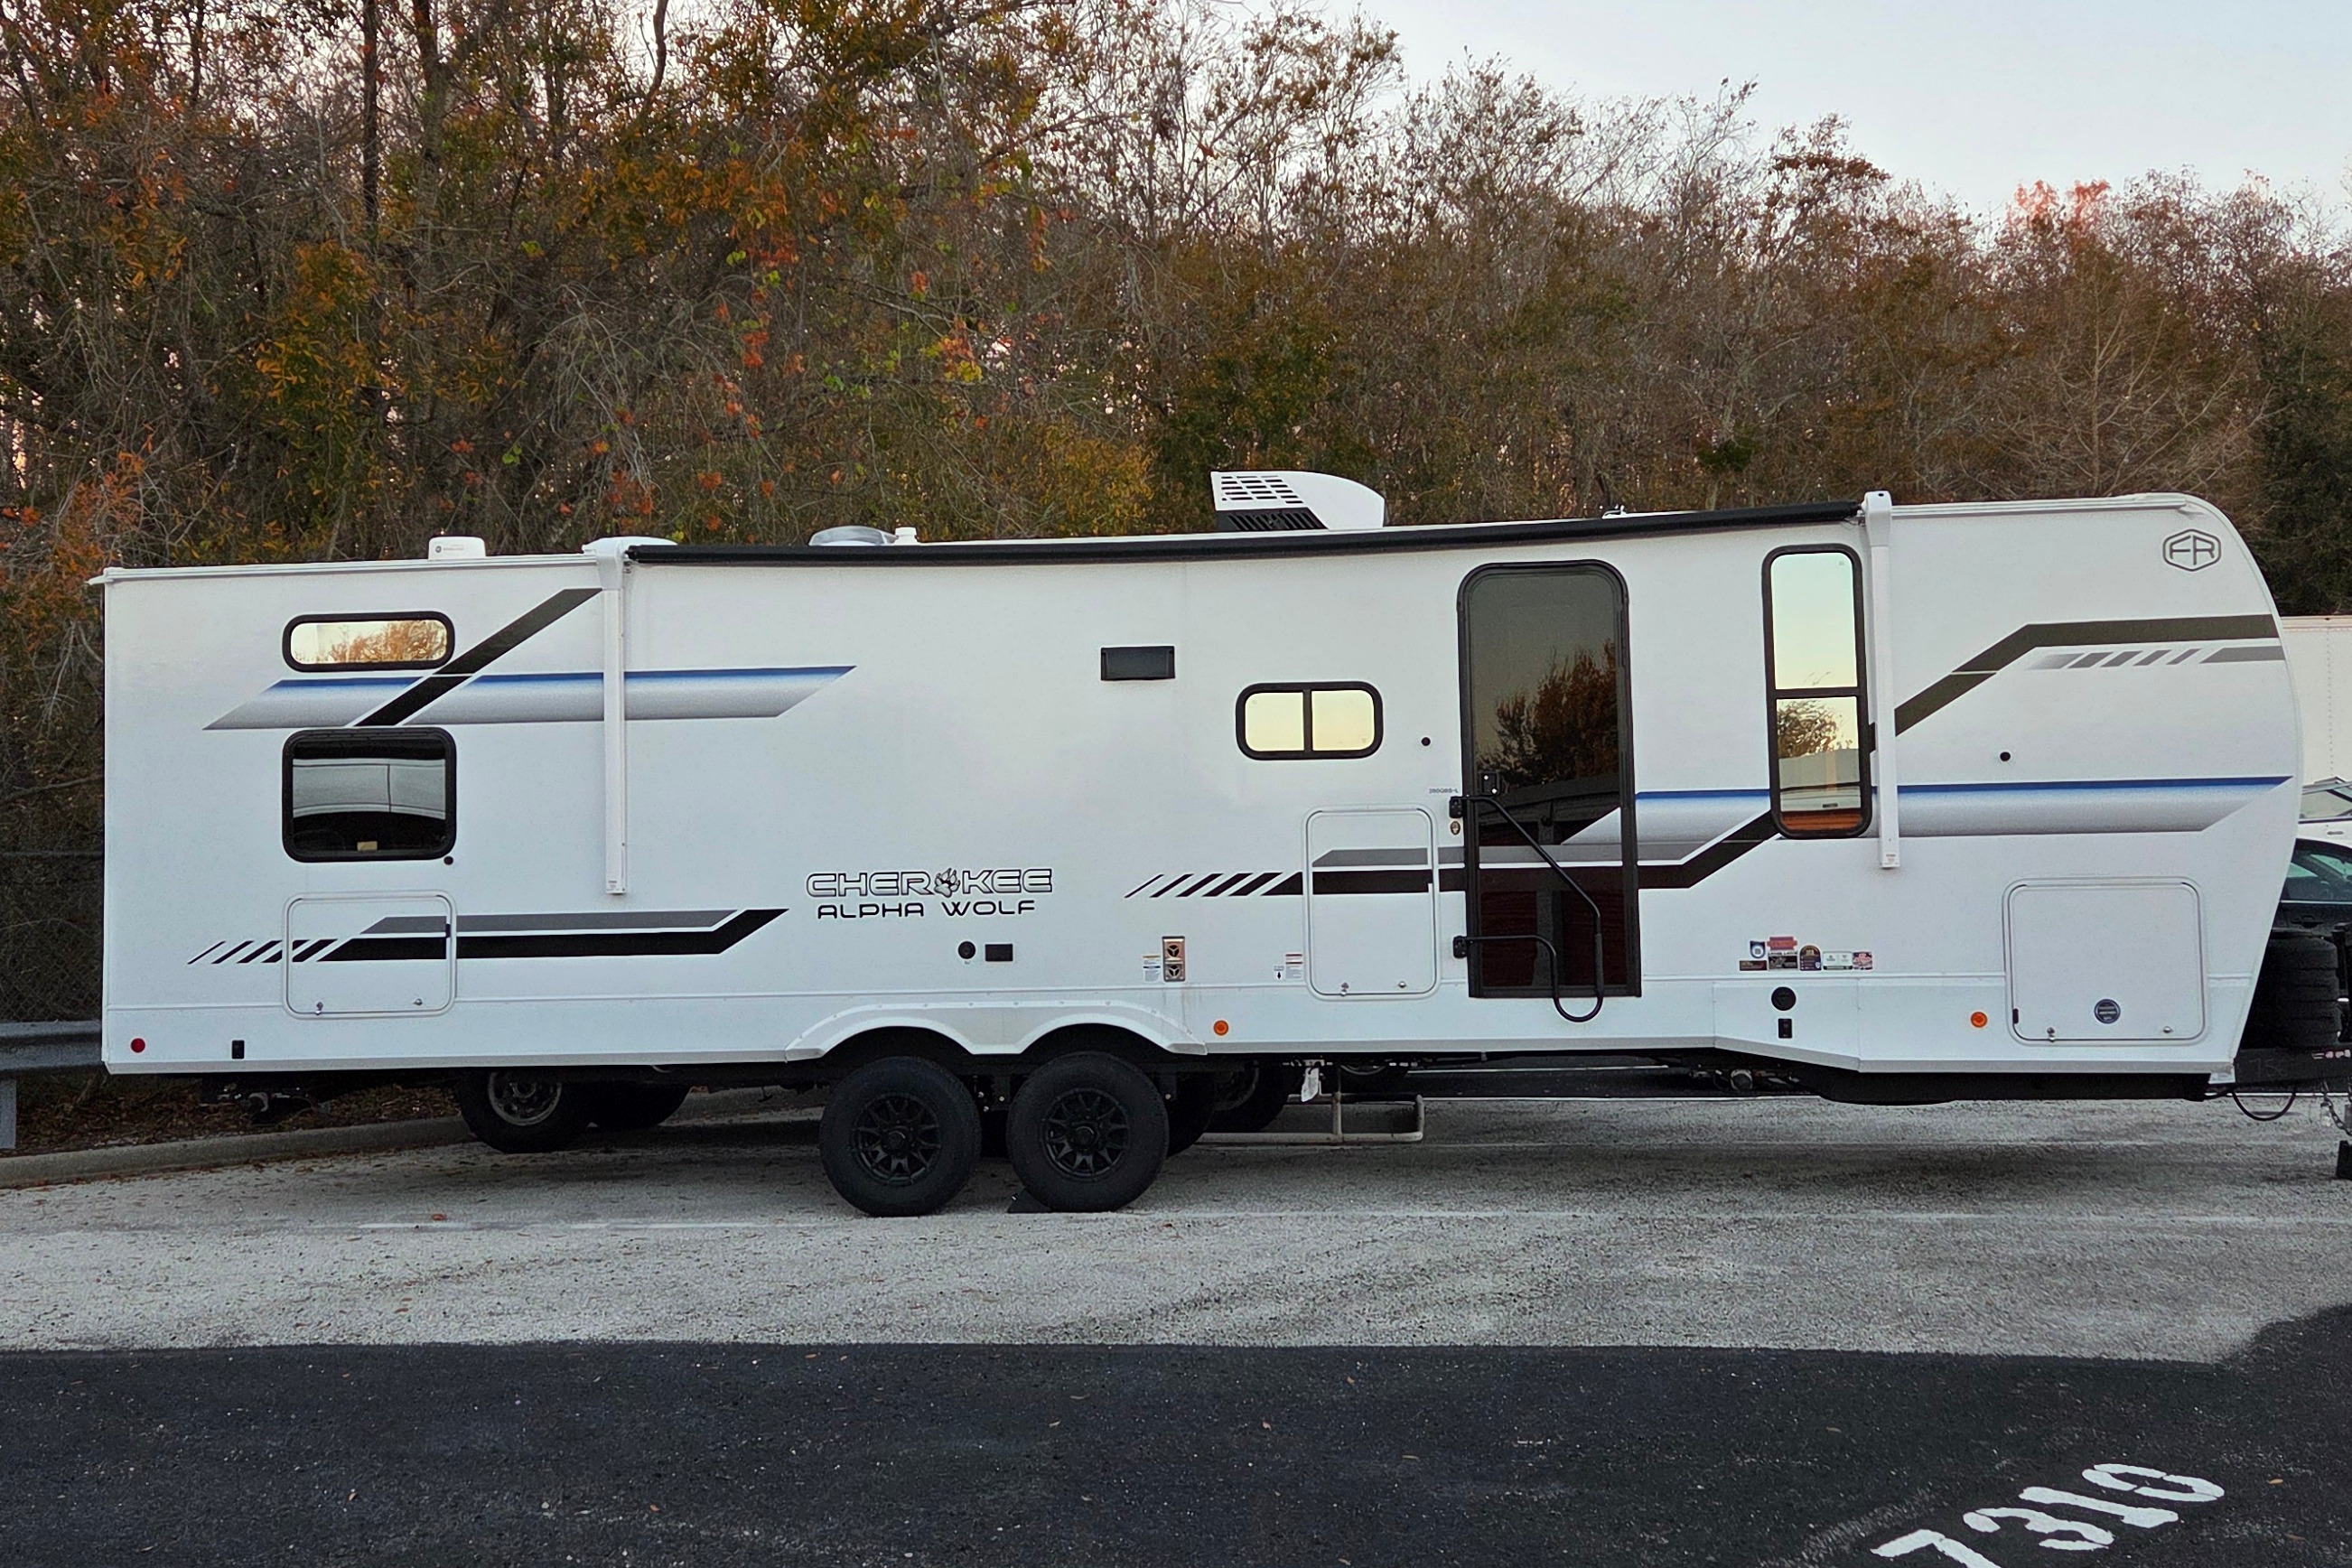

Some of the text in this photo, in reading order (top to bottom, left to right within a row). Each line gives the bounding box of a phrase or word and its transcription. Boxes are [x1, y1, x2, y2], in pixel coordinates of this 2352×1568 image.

[2170, 535, 2215, 565] FR
[817, 900, 1036, 919] ALPHA WOLF
[1870, 1462, 2226, 1568] 7310
